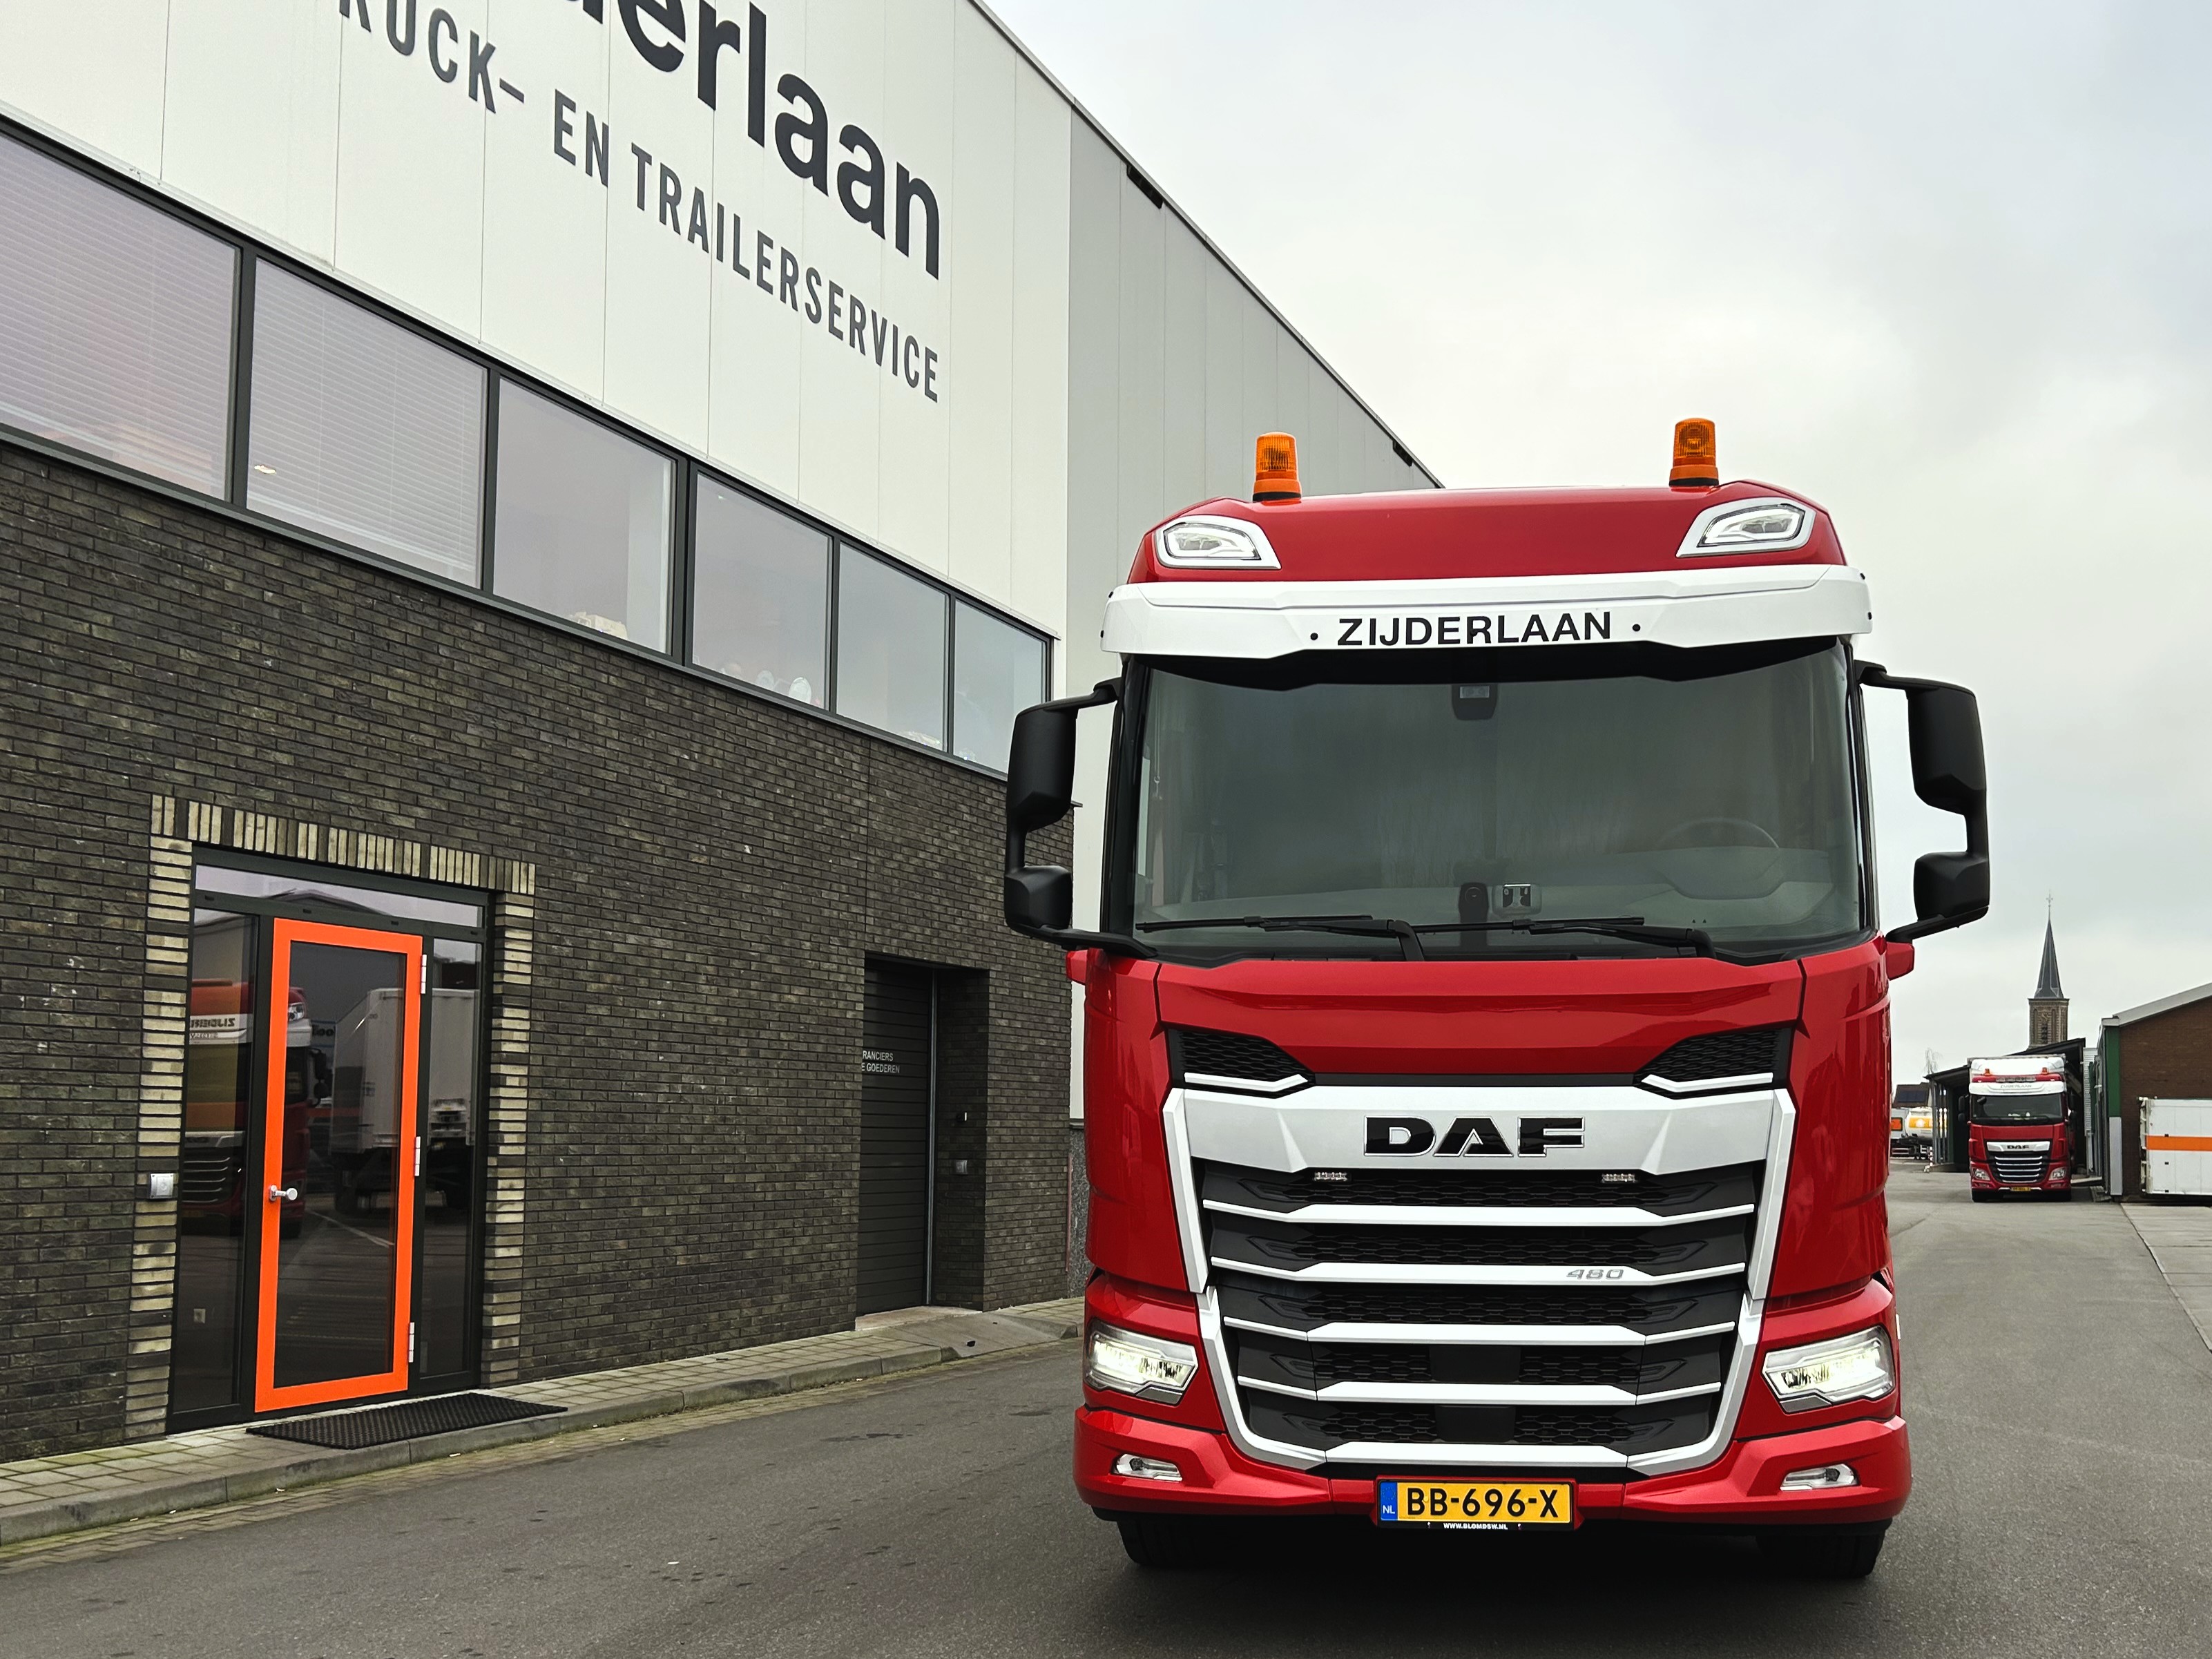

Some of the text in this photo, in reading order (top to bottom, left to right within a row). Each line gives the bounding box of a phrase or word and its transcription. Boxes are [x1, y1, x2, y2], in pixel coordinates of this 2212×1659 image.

[566, 0, 939, 280] erlaan
[554, 89, 609, 188] EN
[631, 142, 938, 403] TRAILERSERVICE
[1337, 611, 1610, 646] ZIJDERLAAN
[866, 1062, 900, 1073] GOEDEREN
[1364, 1115, 1585, 1158] DAF
[1566, 1269, 1624, 1280] 480
[1383, 1504, 1395, 1515] NL
[1407, 1487, 1559, 1518] BB-696-X
